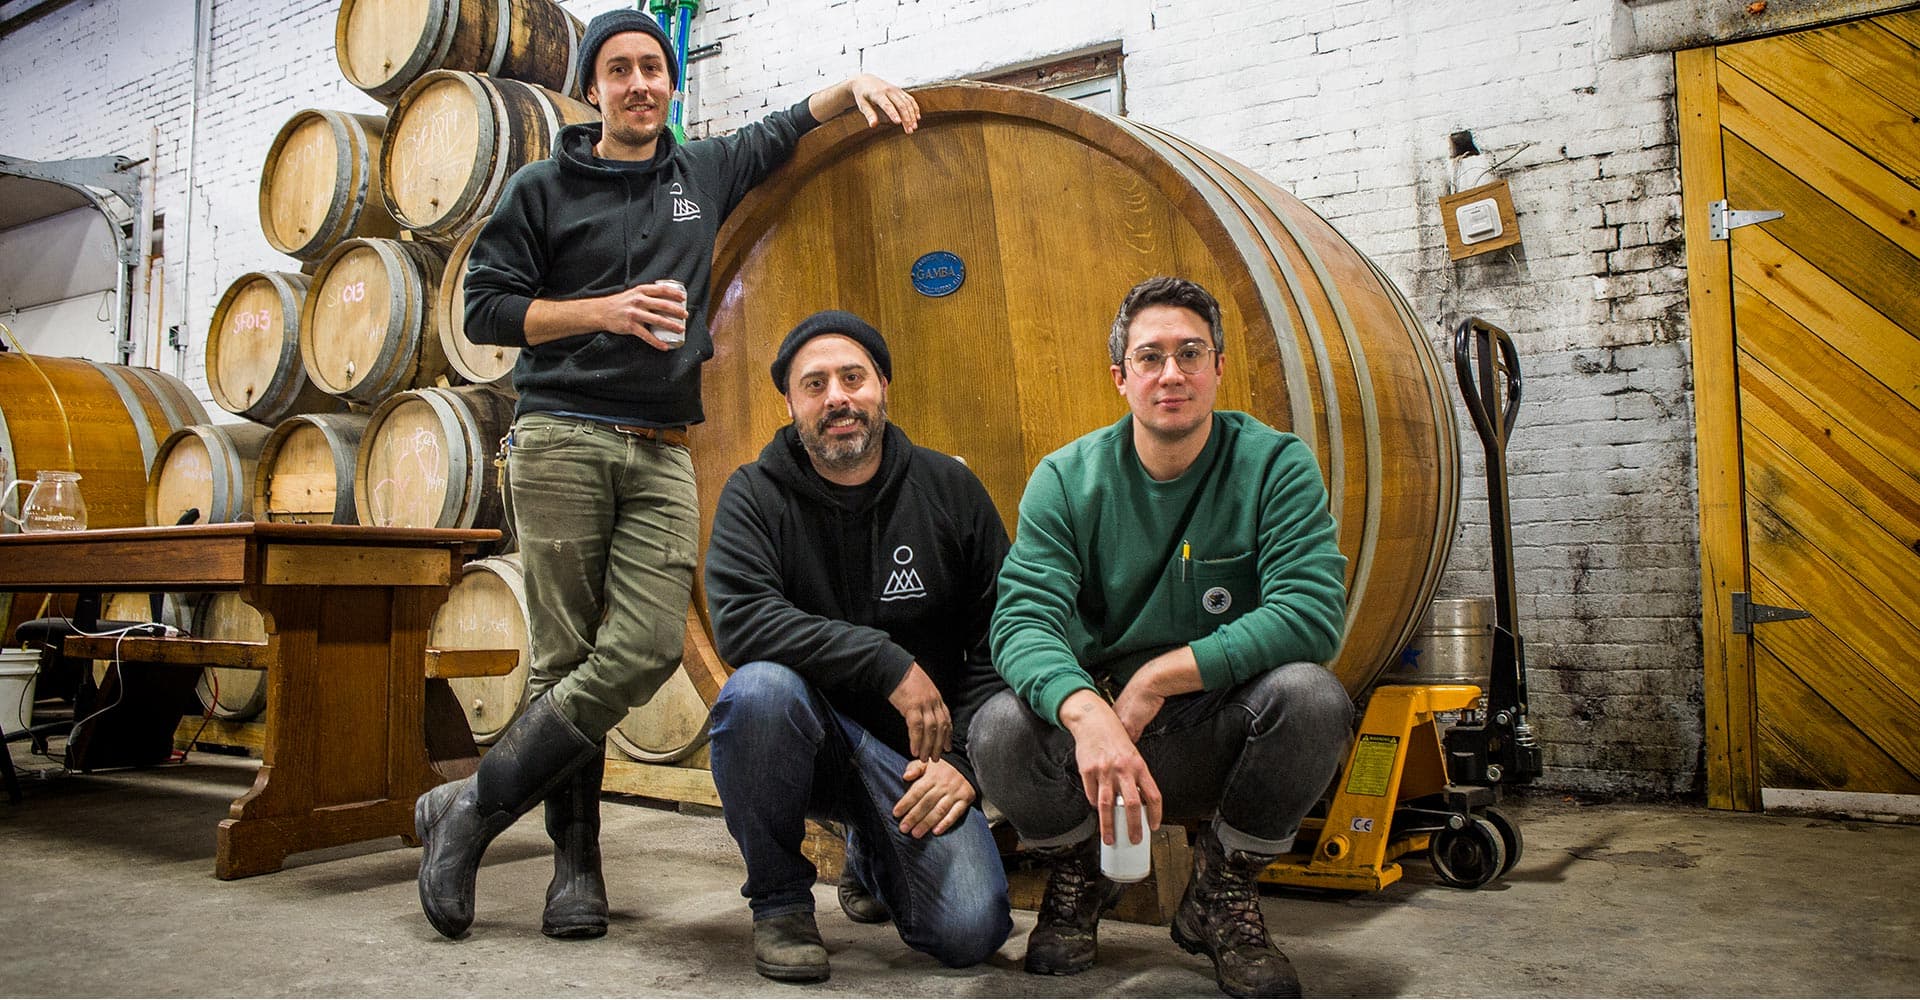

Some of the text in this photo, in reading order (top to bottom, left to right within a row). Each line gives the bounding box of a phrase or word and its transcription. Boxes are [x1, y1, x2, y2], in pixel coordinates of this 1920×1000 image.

[916, 266, 955, 280] GAMBA
[233, 309, 271, 334] SF013
[1353, 818, 1372, 831] CE
